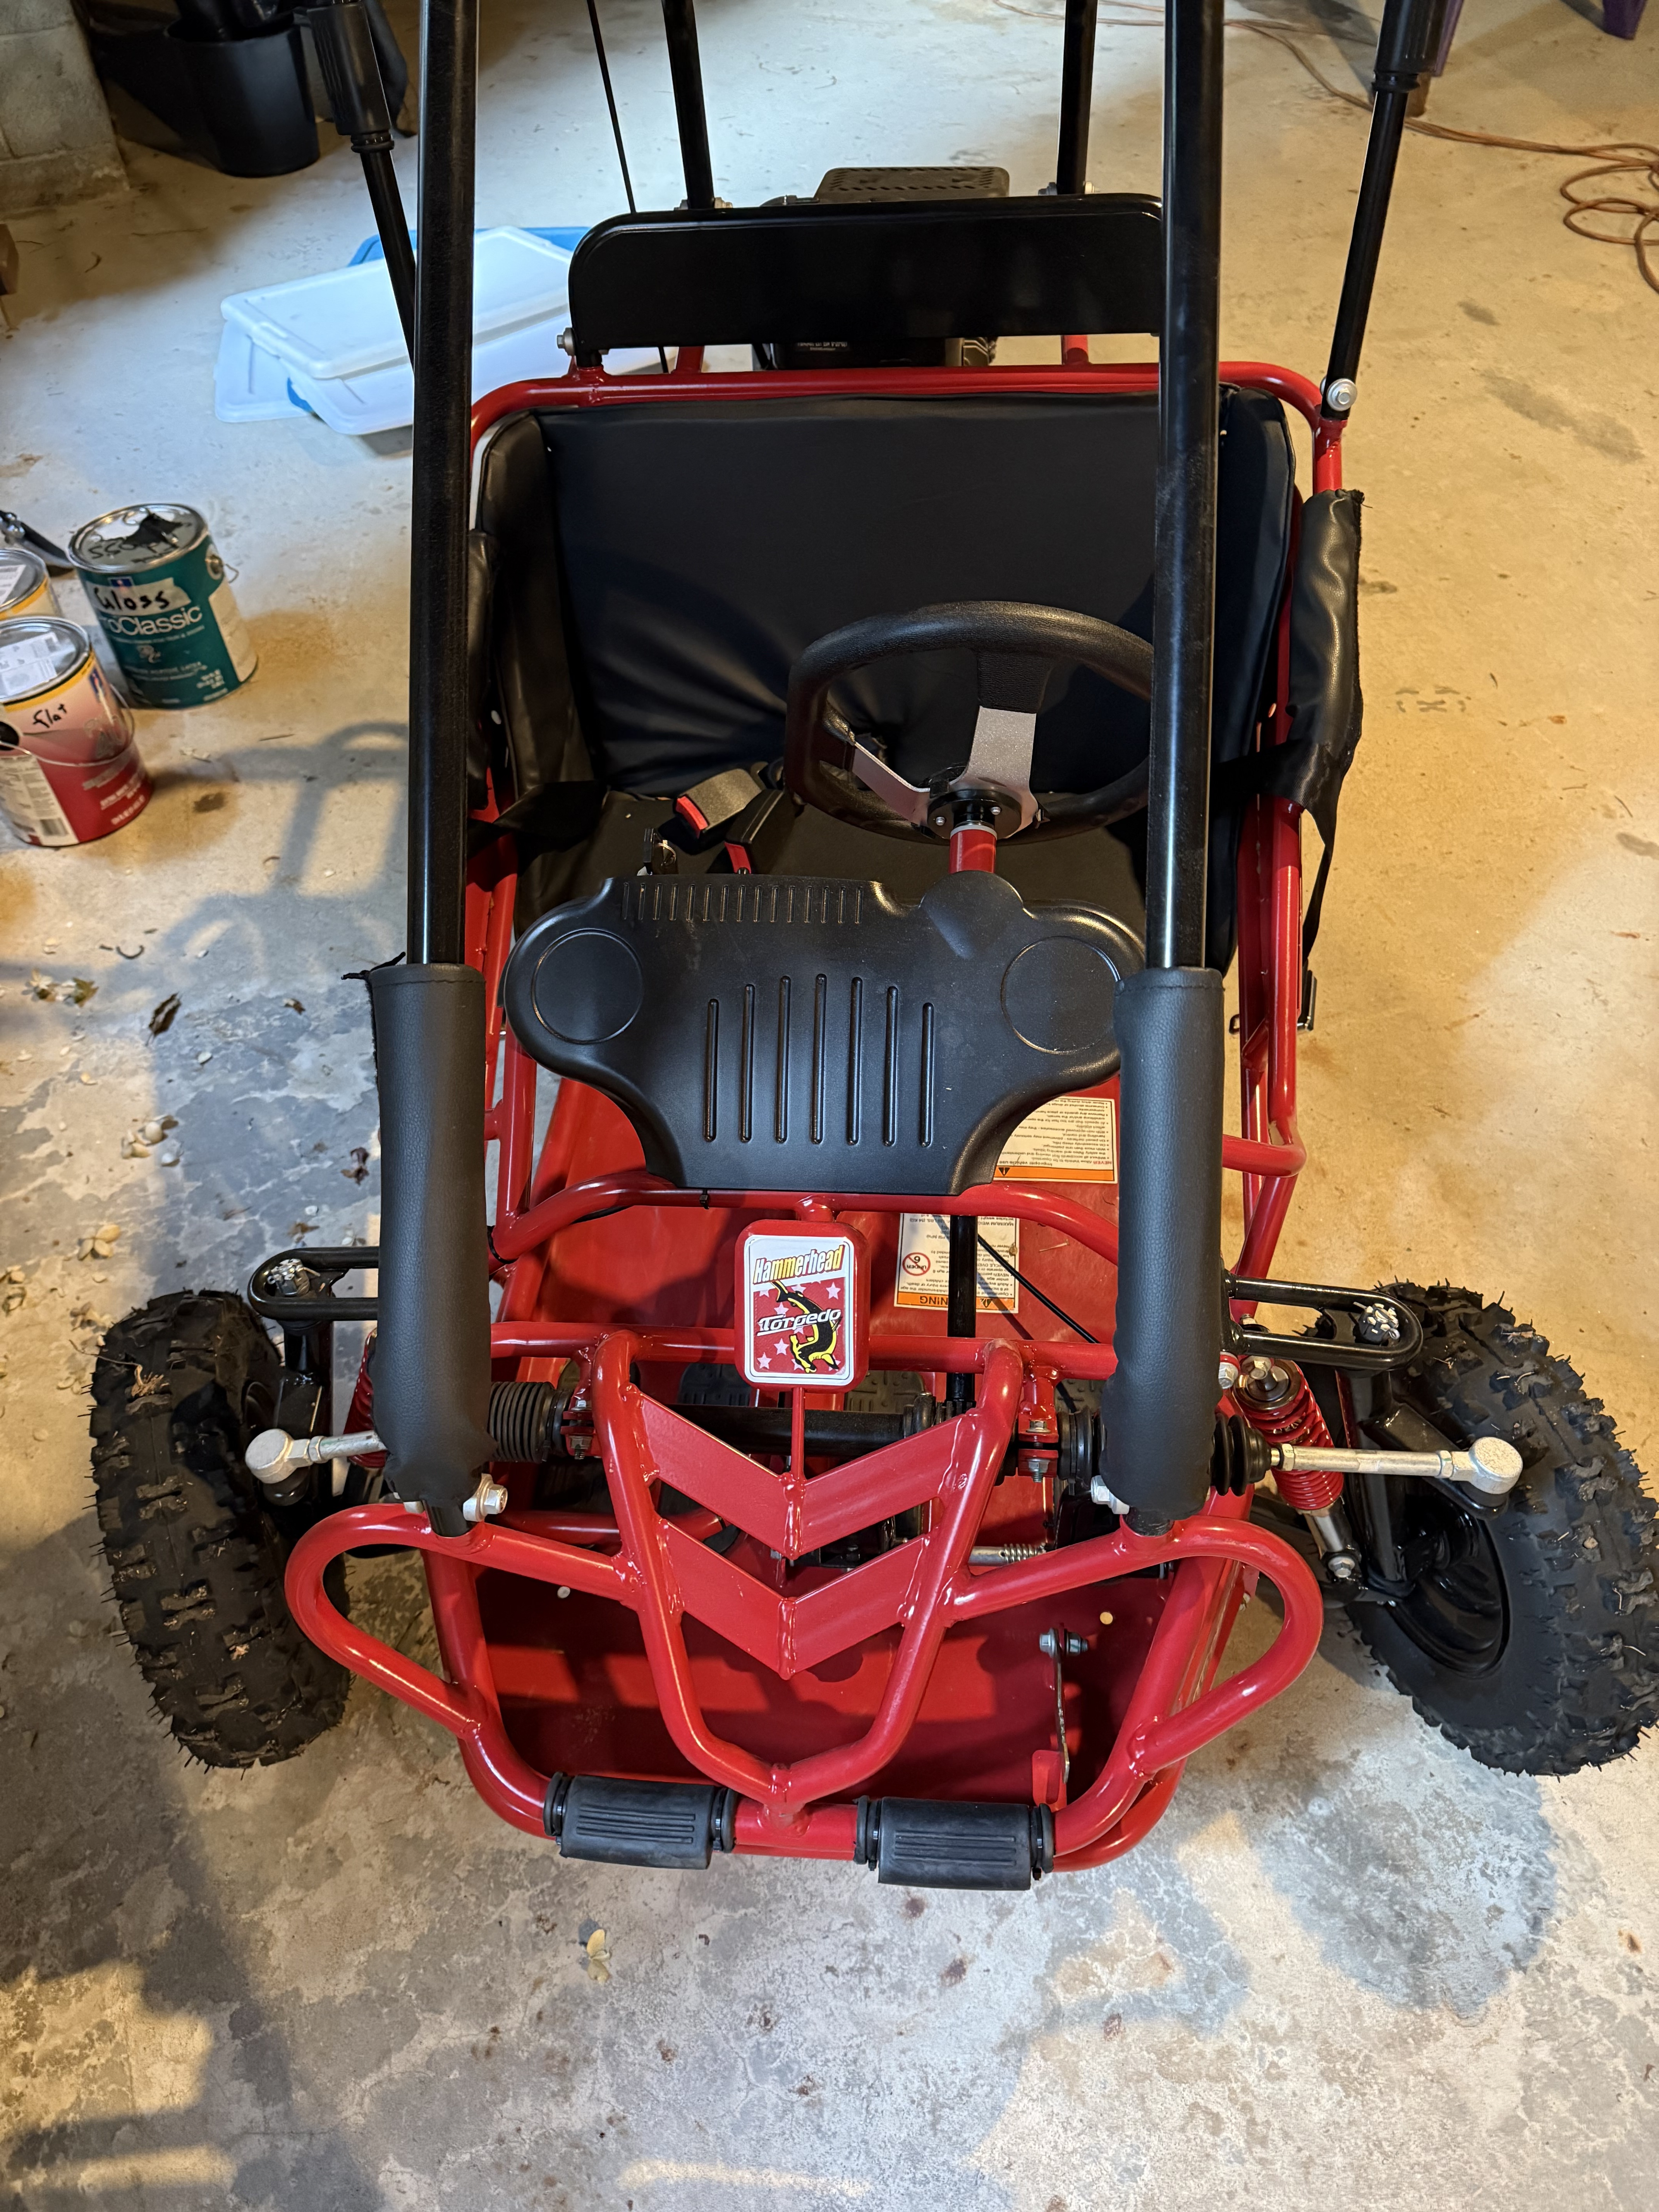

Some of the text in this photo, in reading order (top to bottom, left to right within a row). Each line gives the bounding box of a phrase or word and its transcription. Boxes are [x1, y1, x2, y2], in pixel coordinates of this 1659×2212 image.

[753, 1245, 845, 1285] Hammerhead
[920, 1295, 948, 1305] NING
[757, 1309, 841, 1333] Torpedo
